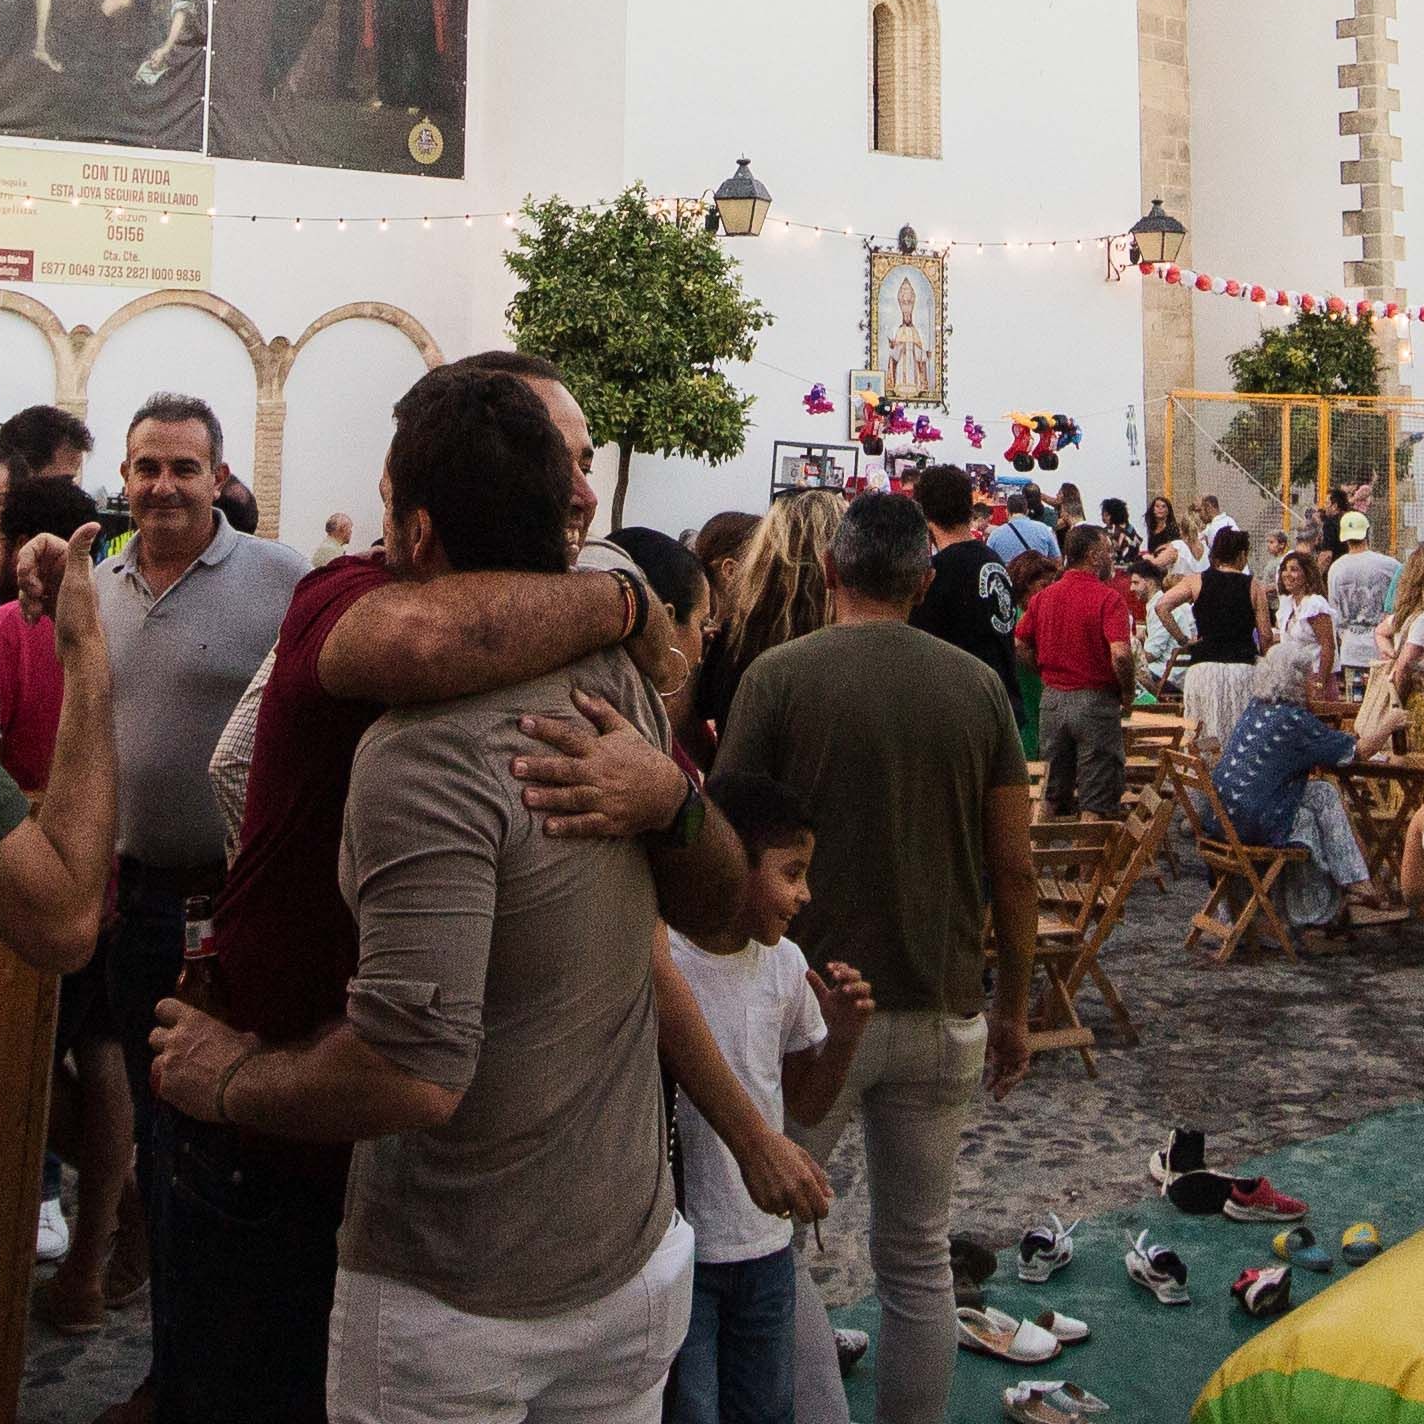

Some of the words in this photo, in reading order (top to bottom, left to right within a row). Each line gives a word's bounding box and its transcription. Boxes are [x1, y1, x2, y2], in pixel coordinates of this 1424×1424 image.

[82, 163, 109, 182] CON
[113, 165, 128, 183] TU
[132, 167, 171, 186] AYUDA
[50, 184, 74, 197] ESTA
[77, 186, 101, 199] JOYA
[147, 191, 199, 207] BRILLANDO
[107, 225, 145, 242] 05156
[103, 250, 121, 262] Cta.
[123, 250, 141, 263] Cte.
[41, 262, 66, 275] ES77
[69, 263, 95, 277] 0049
[98, 265, 123, 278] 7323
[126, 267, 149, 280] 2821
[151, 268, 173, 281] 1000
